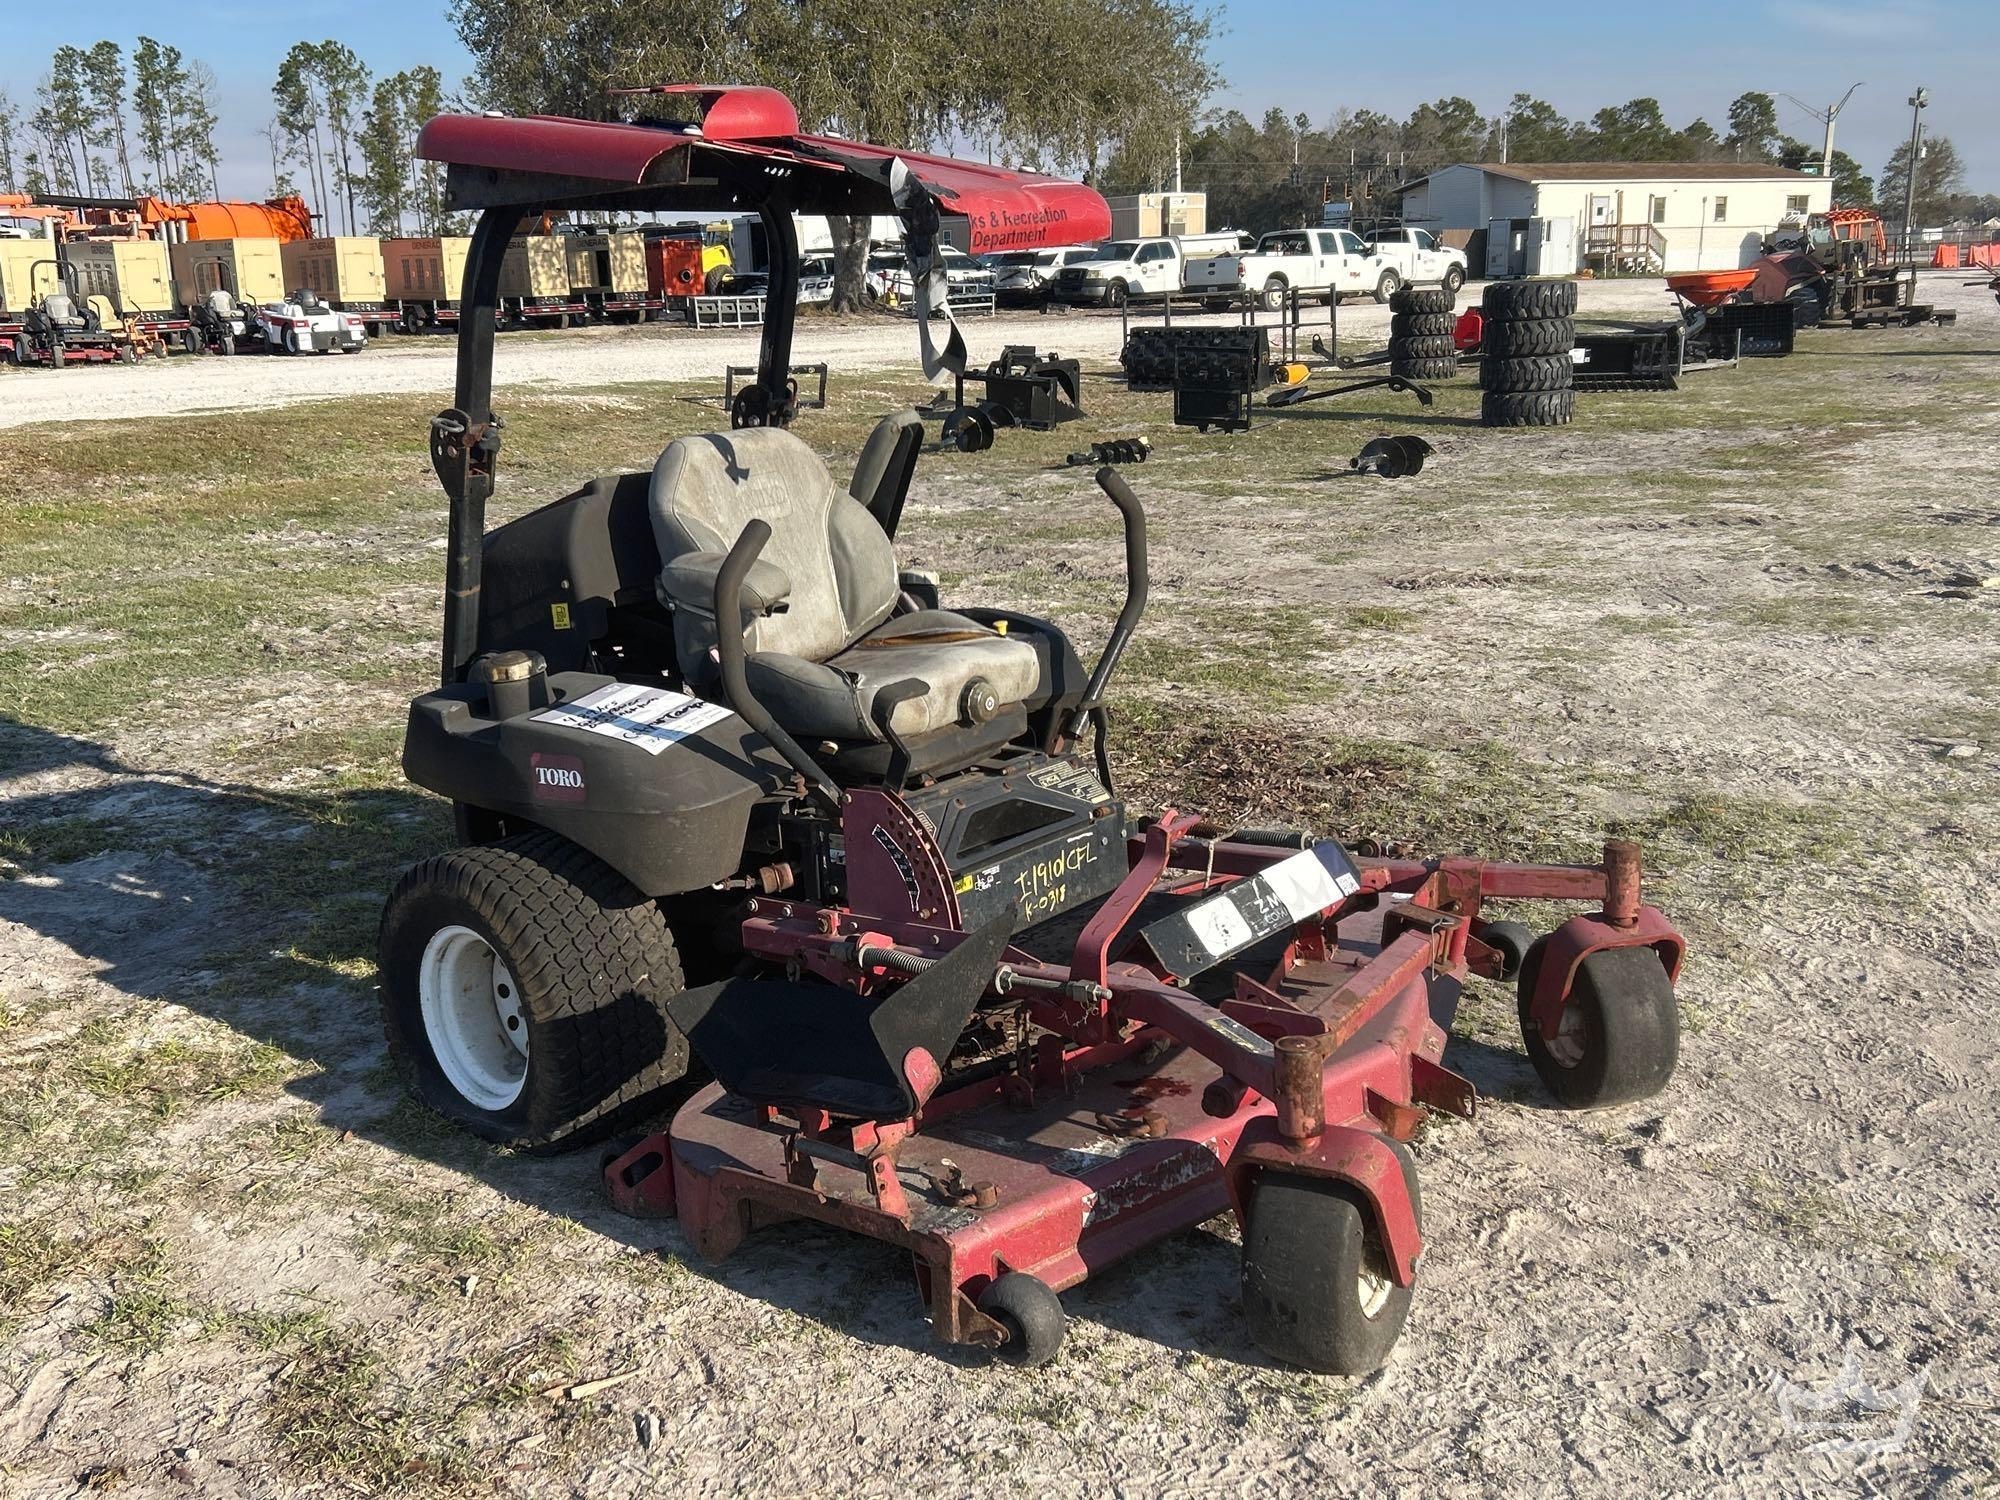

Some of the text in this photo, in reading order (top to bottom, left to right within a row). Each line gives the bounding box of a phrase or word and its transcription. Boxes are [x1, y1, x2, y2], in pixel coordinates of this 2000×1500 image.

[990, 211, 999, 228] &
[1002, 206, 1068, 227] Recreation
[411, 241, 441, 250] GENERAC
[576, 238, 608, 249] GENERAC
[973, 226, 1047, 250] Department
[535, 767, 582, 788] TORO
